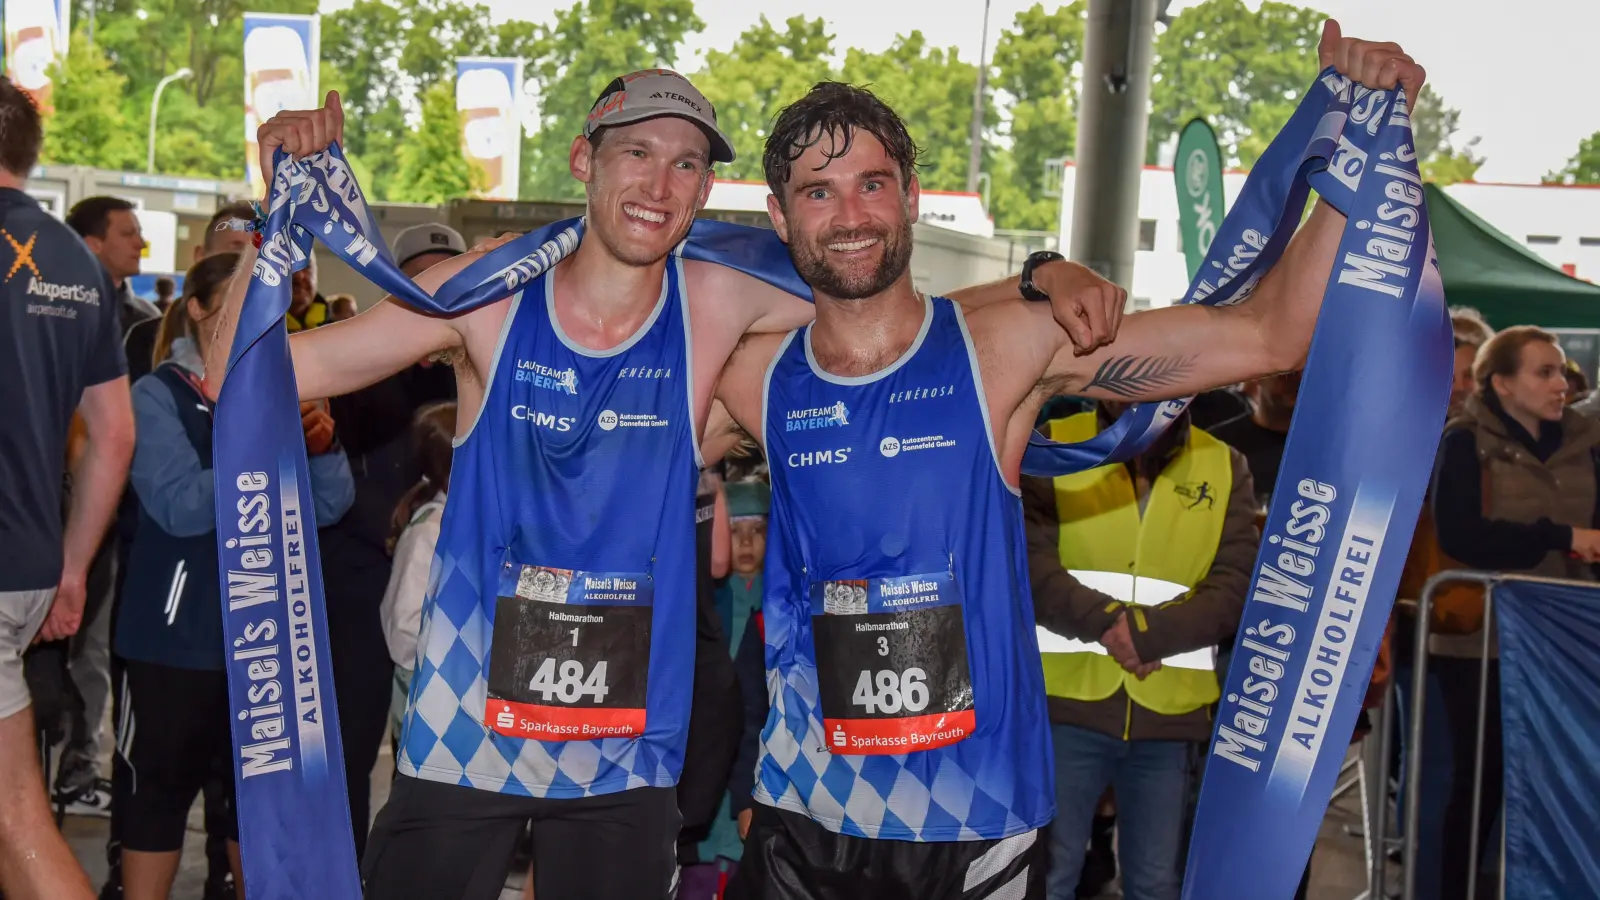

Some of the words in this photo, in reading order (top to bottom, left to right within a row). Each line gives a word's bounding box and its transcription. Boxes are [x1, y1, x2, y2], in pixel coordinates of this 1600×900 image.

[664, 91, 702, 113] TERREX
[26, 276, 100, 306] AixpertSoft
[889, 385, 954, 404] RENÉROSA
[600, 416, 616, 424] AZS
[786, 406, 831, 420] LAUFTEAM
[786, 416, 834, 432] BAYERN
[882, 442, 898, 452] AZS
[902, 435, 944, 445] Autozentrum
[902, 442, 935, 452] Sonnefeld
[936, 439, 956, 449] GmbH
[225, 471, 279, 612] Weisse
[1253, 478, 1337, 613] Weisse
[584, 578, 611, 590] Maisel's
[613, 578, 637, 590] Weisse
[880, 583, 911, 598] Maisel's
[911, 580, 938, 594] Weisse
[584, 593, 635, 601] ALKOHOLFREI
[882, 594, 939, 607] ALKOHOLFREI
[285, 509, 318, 724] ALKOHOLFREI
[549, 611, 604, 623] Halbmarathon
[855, 621, 909, 632] Halbmarathon
[570, 627, 579, 647] 1
[877, 636, 890, 657] 3
[1291, 534, 1374, 750] ALKOHOLFREI
[529, 657, 609, 703] 484
[233, 618, 293, 780] Maisel's
[852, 667, 930, 714] 486
[1213, 618, 1296, 772] Maisel's
[519, 718, 579, 734] Sparkasse
[582, 723, 633, 736] Bayreuth
[851, 735, 907, 748] Sparkasse
[911, 727, 964, 745] Bayreuth
